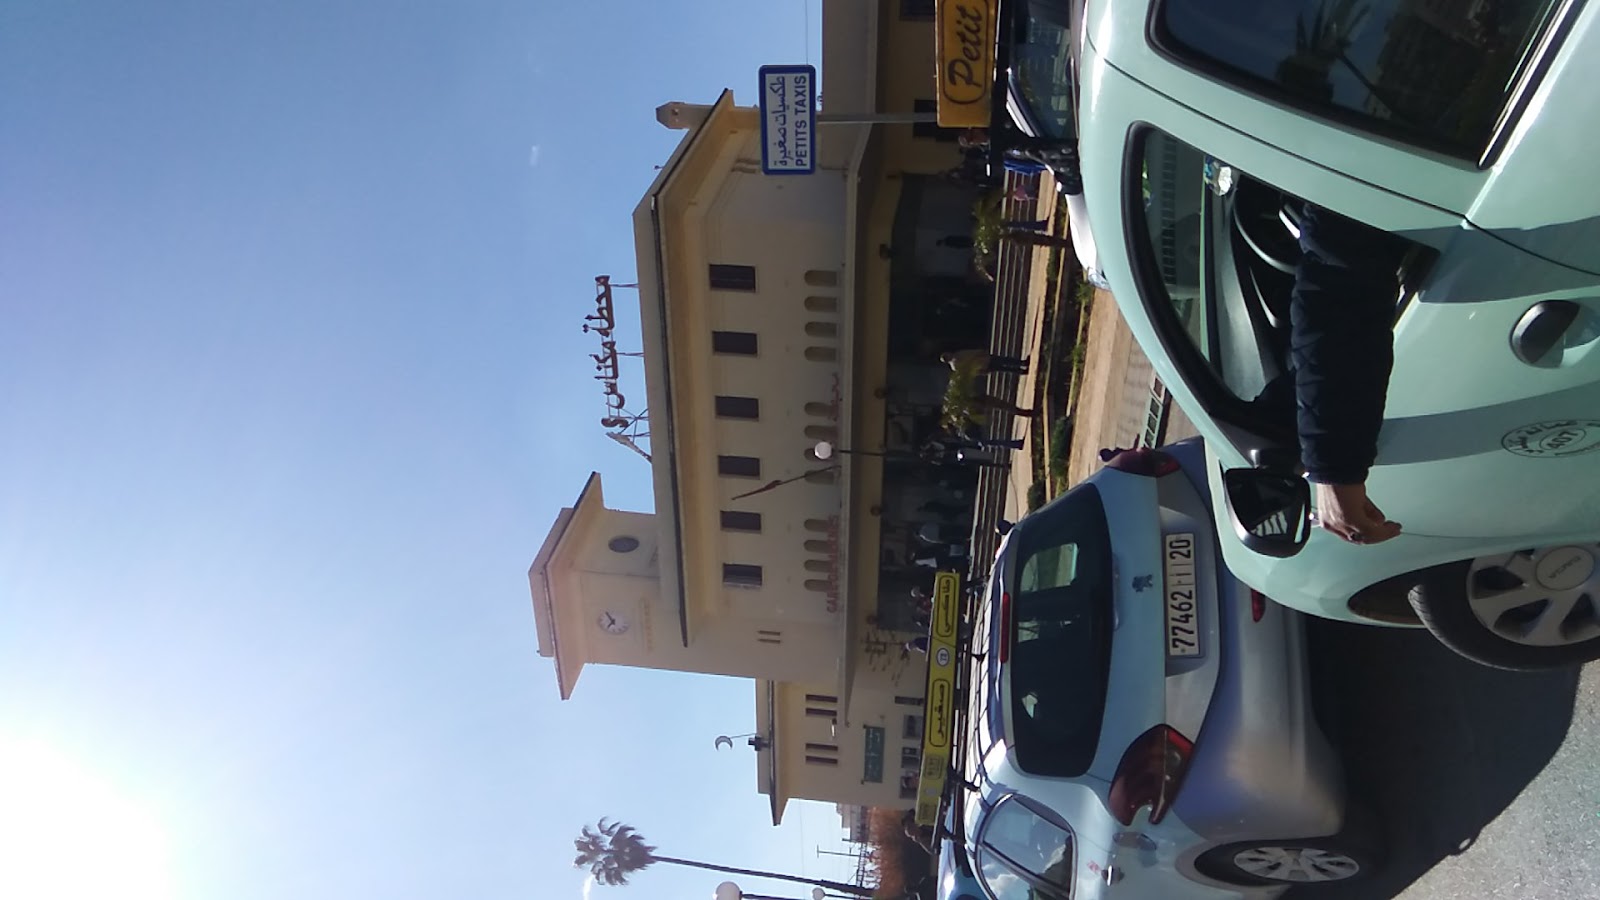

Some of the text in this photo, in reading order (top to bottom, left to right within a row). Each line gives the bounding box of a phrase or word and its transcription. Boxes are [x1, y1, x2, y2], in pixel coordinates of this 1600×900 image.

[948, 4, 982, 88] Petit
[773, 128, 793, 167] صغيرة
[793, 75, 808, 167] PETITS TAXIS
[582, 275, 625, 410] محطة مكناس
[1546, 431, 1579, 449] 407
[1169, 540, 1191, 560] 20
[1170, 590, 1195, 648] 77462
